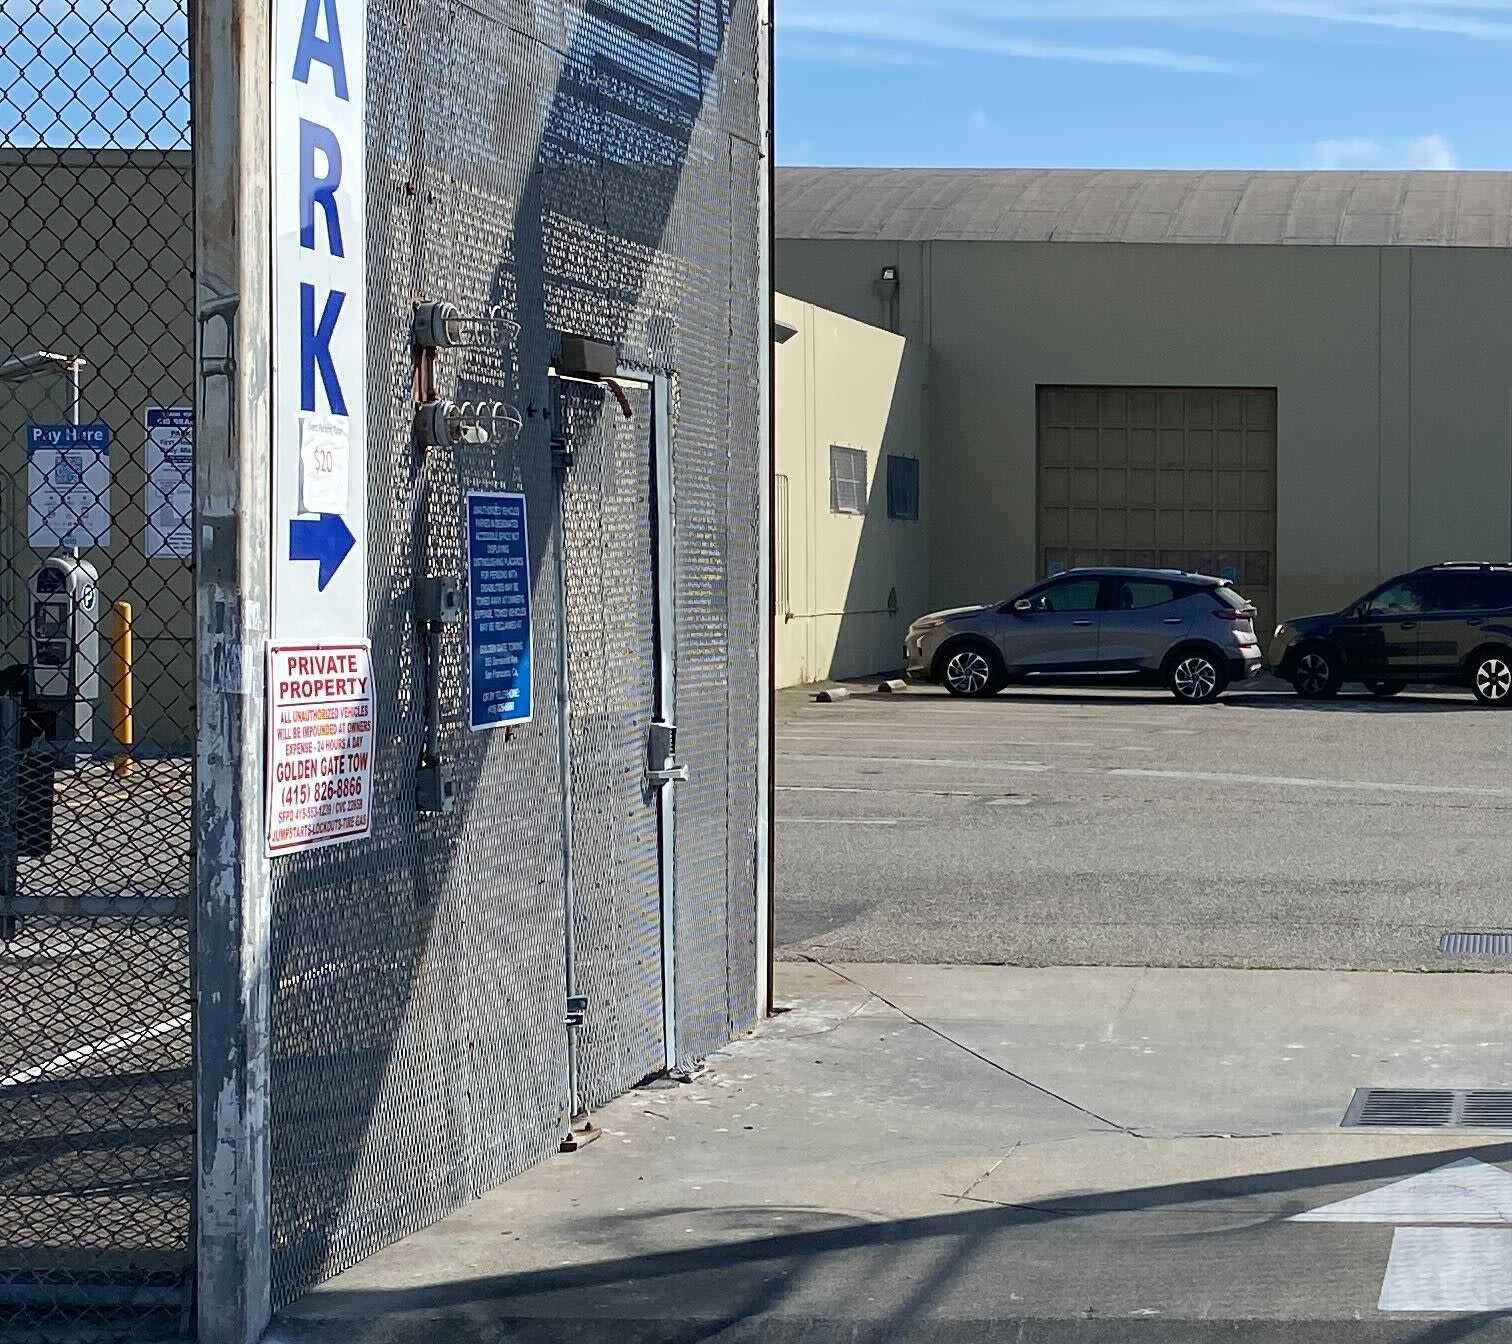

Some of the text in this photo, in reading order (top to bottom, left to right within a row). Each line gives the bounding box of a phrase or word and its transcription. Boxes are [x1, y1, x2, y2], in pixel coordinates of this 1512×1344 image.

[313, 447, 333, 473] $20
[287, 654, 358, 676] PRIVATE
[279, 676, 368, 699] PROPERTY
[280, 704, 369, 723] ALL UNAUTHORIZED VEHICLES
[277, 728, 291, 741] WILL
[292, 726, 300, 739] BE
[302, 723, 337, 738] IMPOUNDED
[338, 722, 346, 734] AT
[285, 741, 313, 756] EXPENSE
[317, 740, 324, 753] 24
[325, 738, 346, 752] HOURS
[352, 735, 364, 748] DAY
[276, 752, 369, 783] GOLDEN GATE TOW
[281, 776, 362, 806] (415) 826-8866
